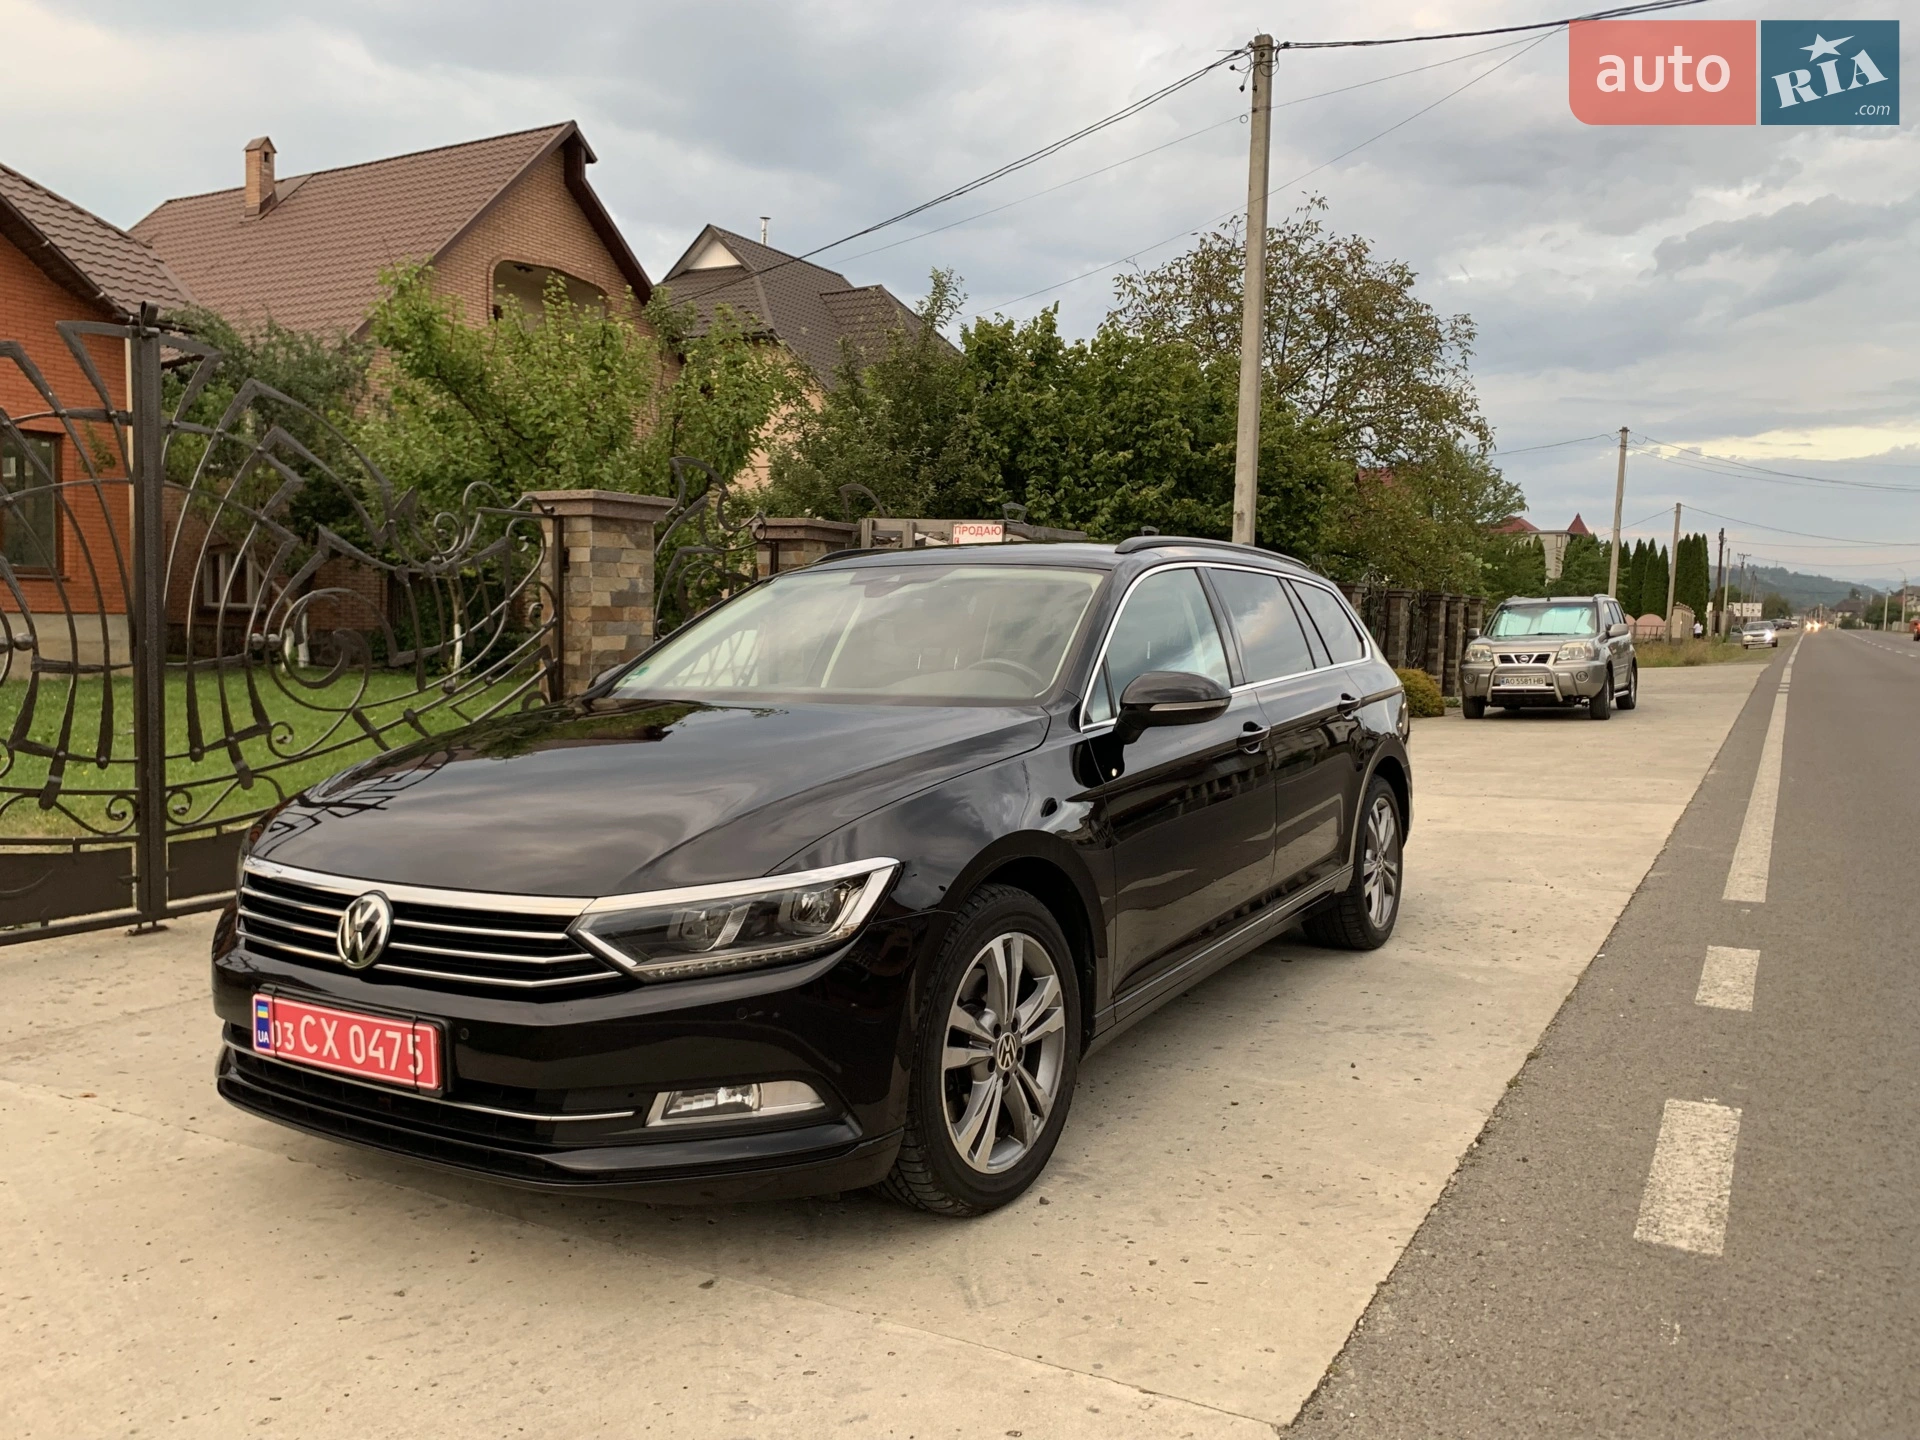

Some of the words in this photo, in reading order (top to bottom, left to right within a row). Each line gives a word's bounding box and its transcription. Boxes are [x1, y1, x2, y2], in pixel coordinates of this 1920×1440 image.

[954, 525, 1002, 536] ПРОДАЮ
[257, 1029, 270, 1044] UA
[300, 1014, 341, 1060] CX
[349, 1024, 424, 1076] 0475
